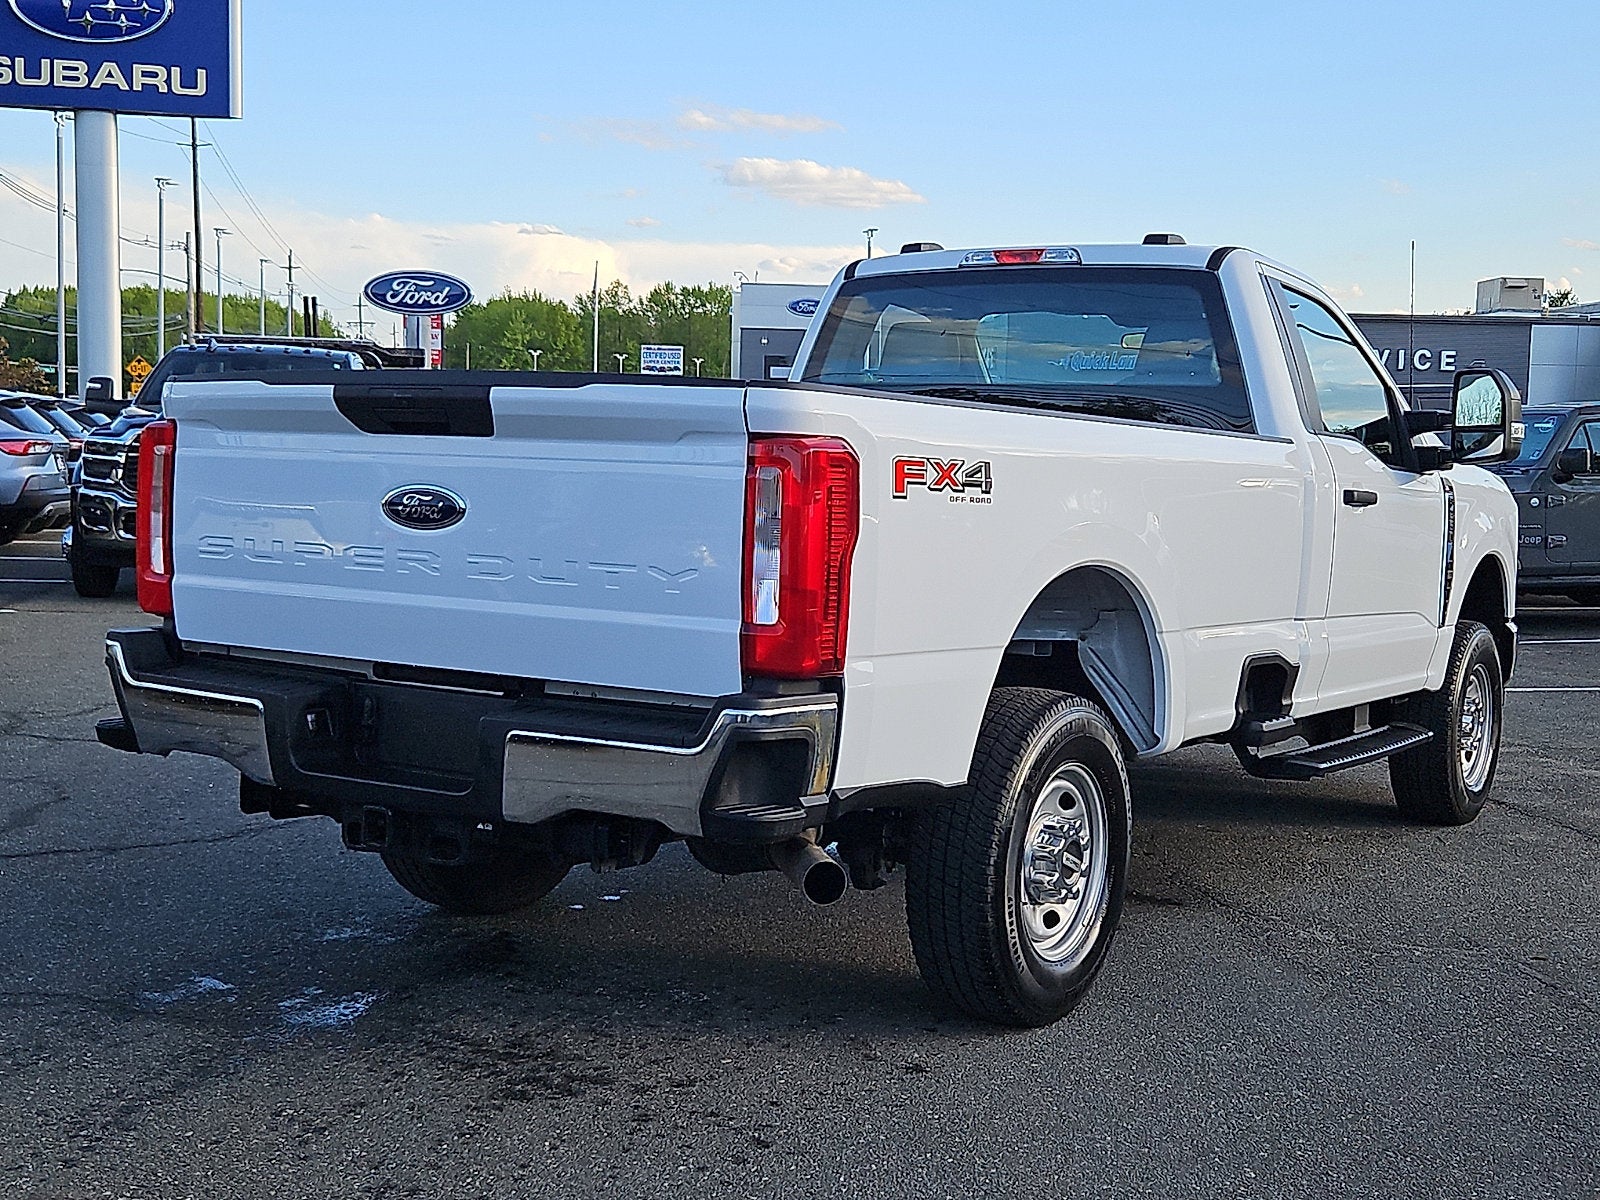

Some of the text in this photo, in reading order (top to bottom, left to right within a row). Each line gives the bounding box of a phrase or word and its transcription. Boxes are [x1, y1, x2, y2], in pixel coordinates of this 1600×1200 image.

[386, 278, 450, 305] Ford
[796, 301, 818, 312] For
[1071, 351, 1110, 371] Quick
[892, 456, 992, 499] FX4
[400, 494, 443, 519] Ford
[1518, 534, 1542, 545] Jeep
[199, 536, 698, 594] SUPER DUTY
